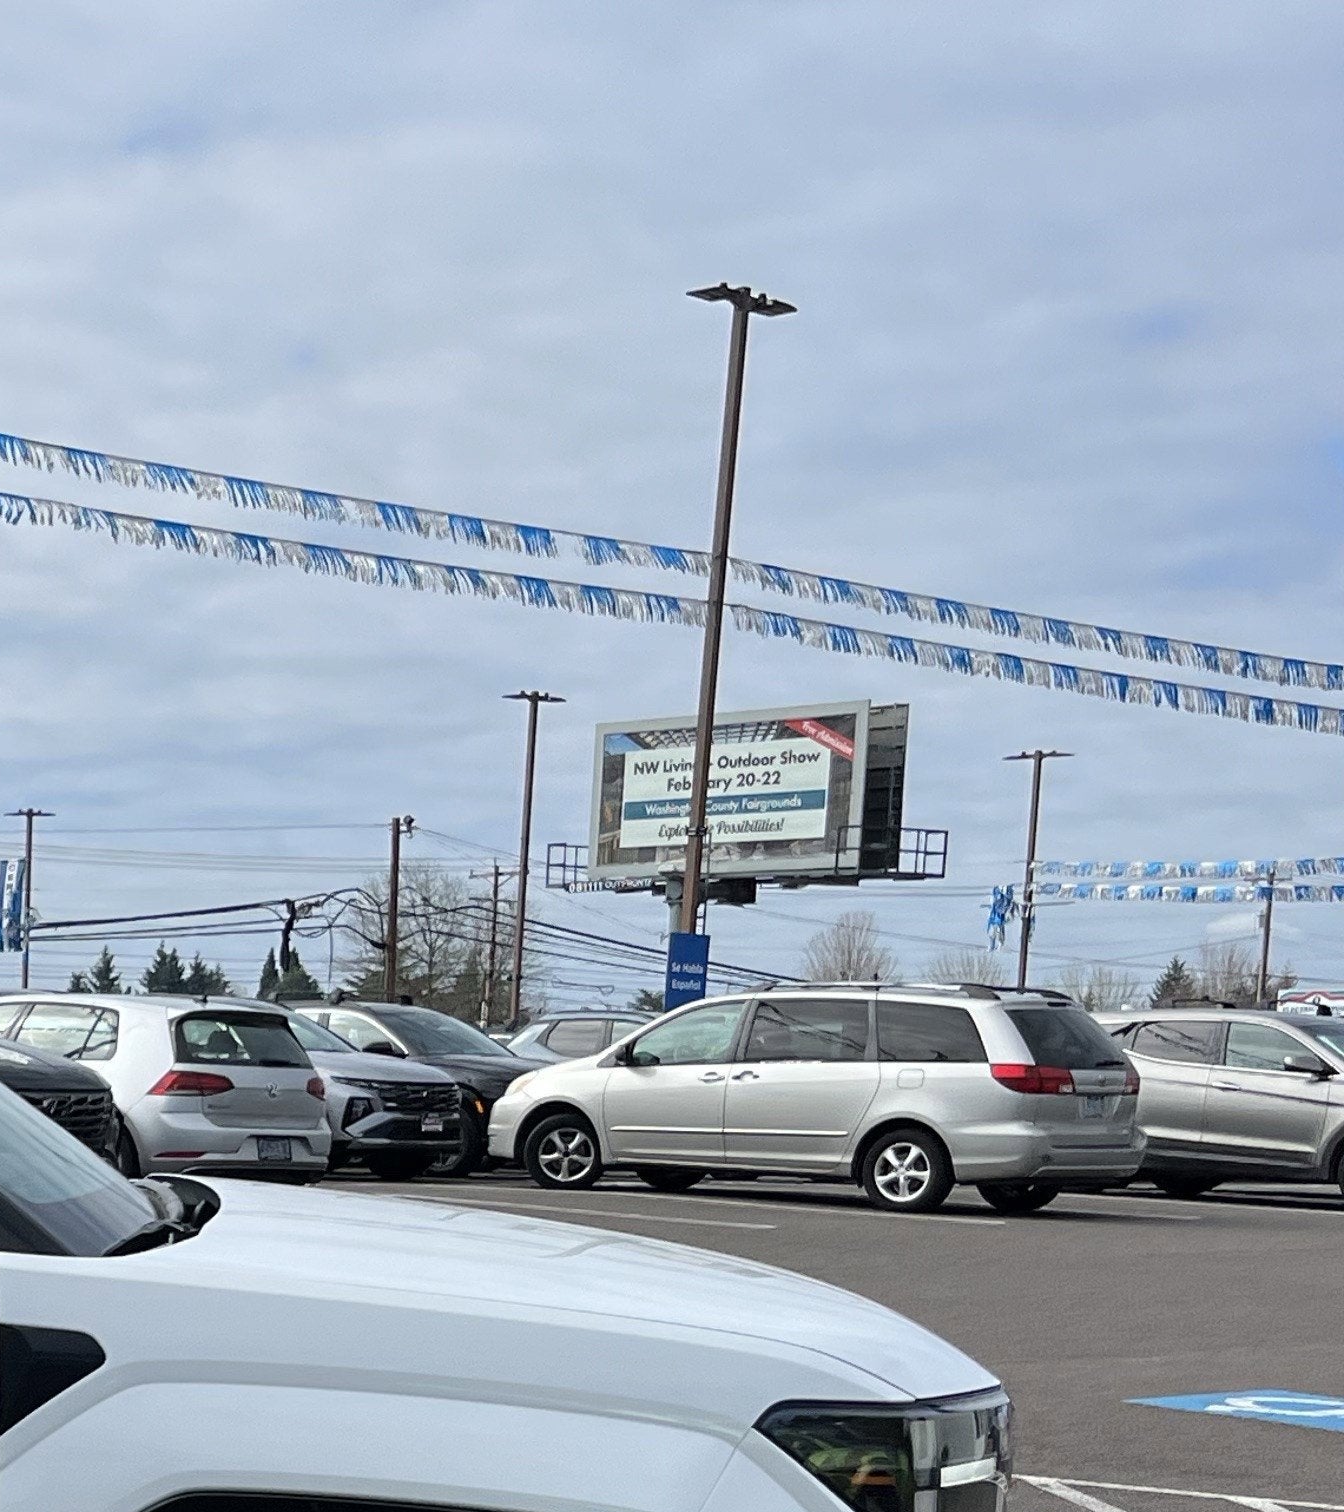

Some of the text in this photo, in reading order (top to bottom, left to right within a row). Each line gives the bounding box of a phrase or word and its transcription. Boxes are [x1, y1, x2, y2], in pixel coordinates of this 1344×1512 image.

[633, 749, 820, 775] NW Livin Outdoor Show
[667, 771, 781, 793] Febary 20-22
[645, 794, 802, 817] Washingt County Fairgrounds
[717, 817, 785, 835] Possibilities!
